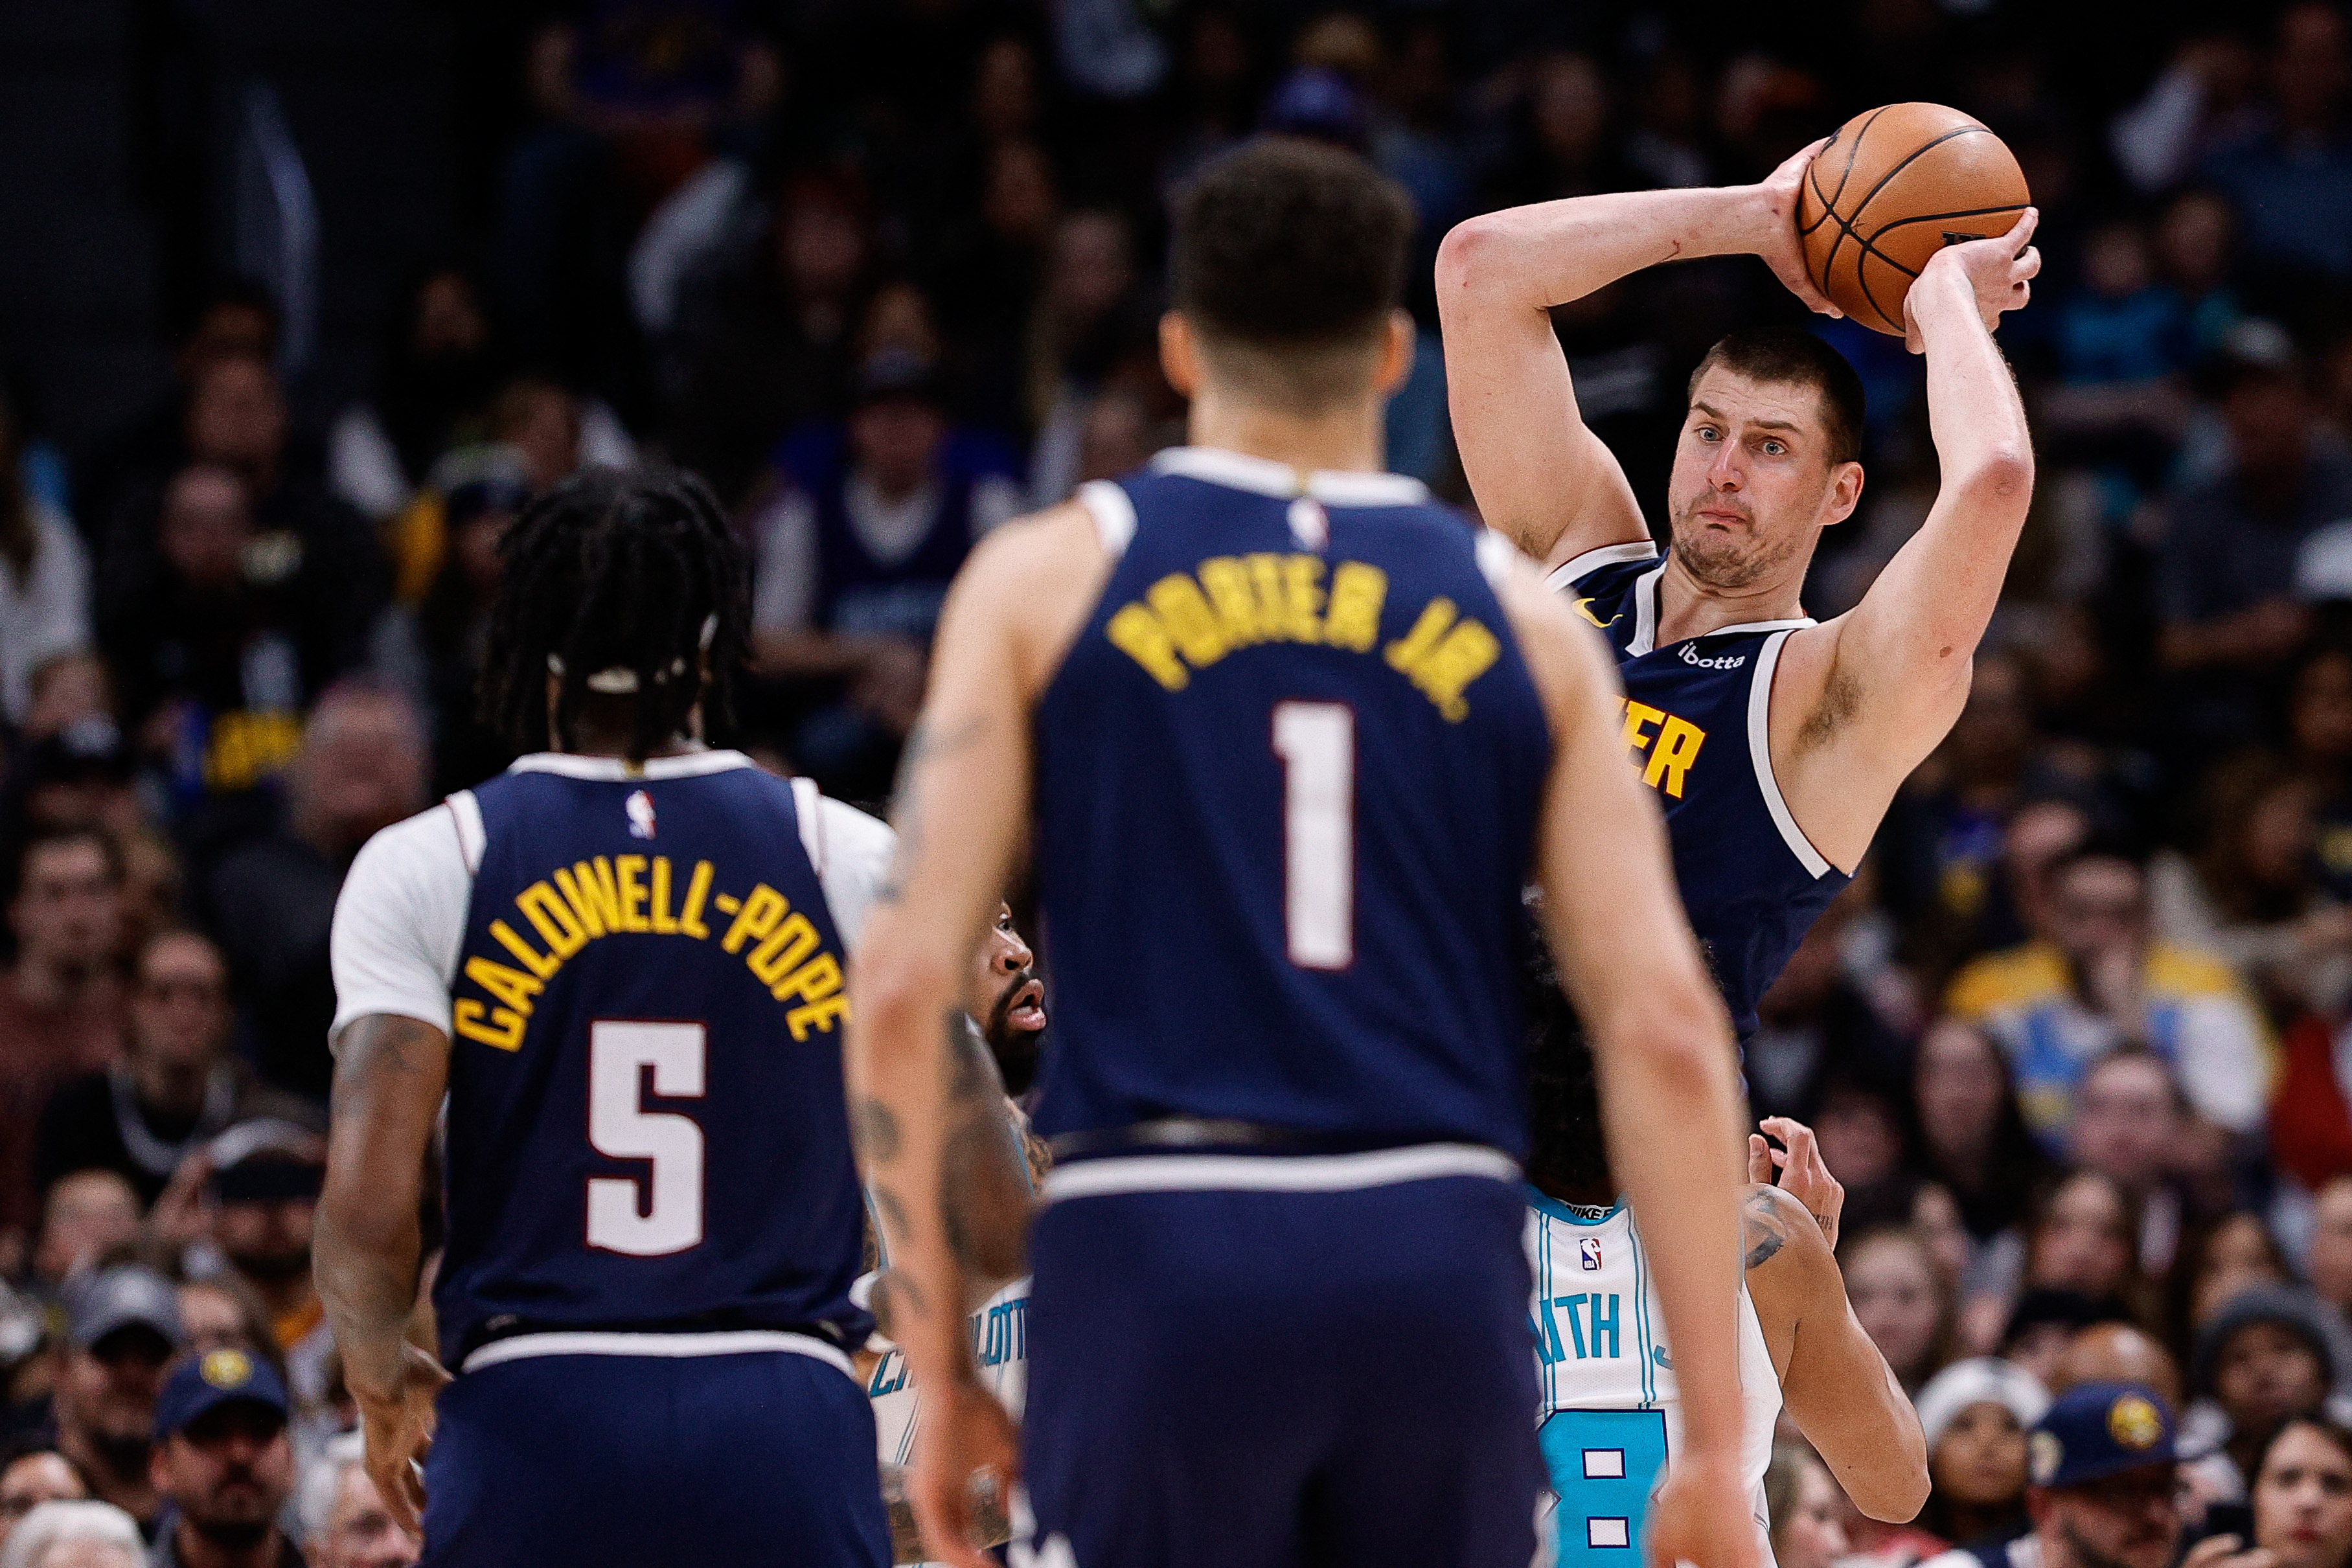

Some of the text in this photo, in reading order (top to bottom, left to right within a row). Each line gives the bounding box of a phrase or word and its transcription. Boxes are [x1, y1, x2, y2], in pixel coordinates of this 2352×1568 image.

[1108, 552, 1387, 692] PORTER
[1678, 641, 1745, 670] ibotta
[1619, 698, 1708, 801] ER
[1270, 698, 1355, 971] 1
[455, 854, 852, 1052] CALDWELL-POPE
[586, 1018, 707, 1257] 5
[1525, 1293, 1619, 1366] ITH
[1538, 1409, 1670, 1568] 8
